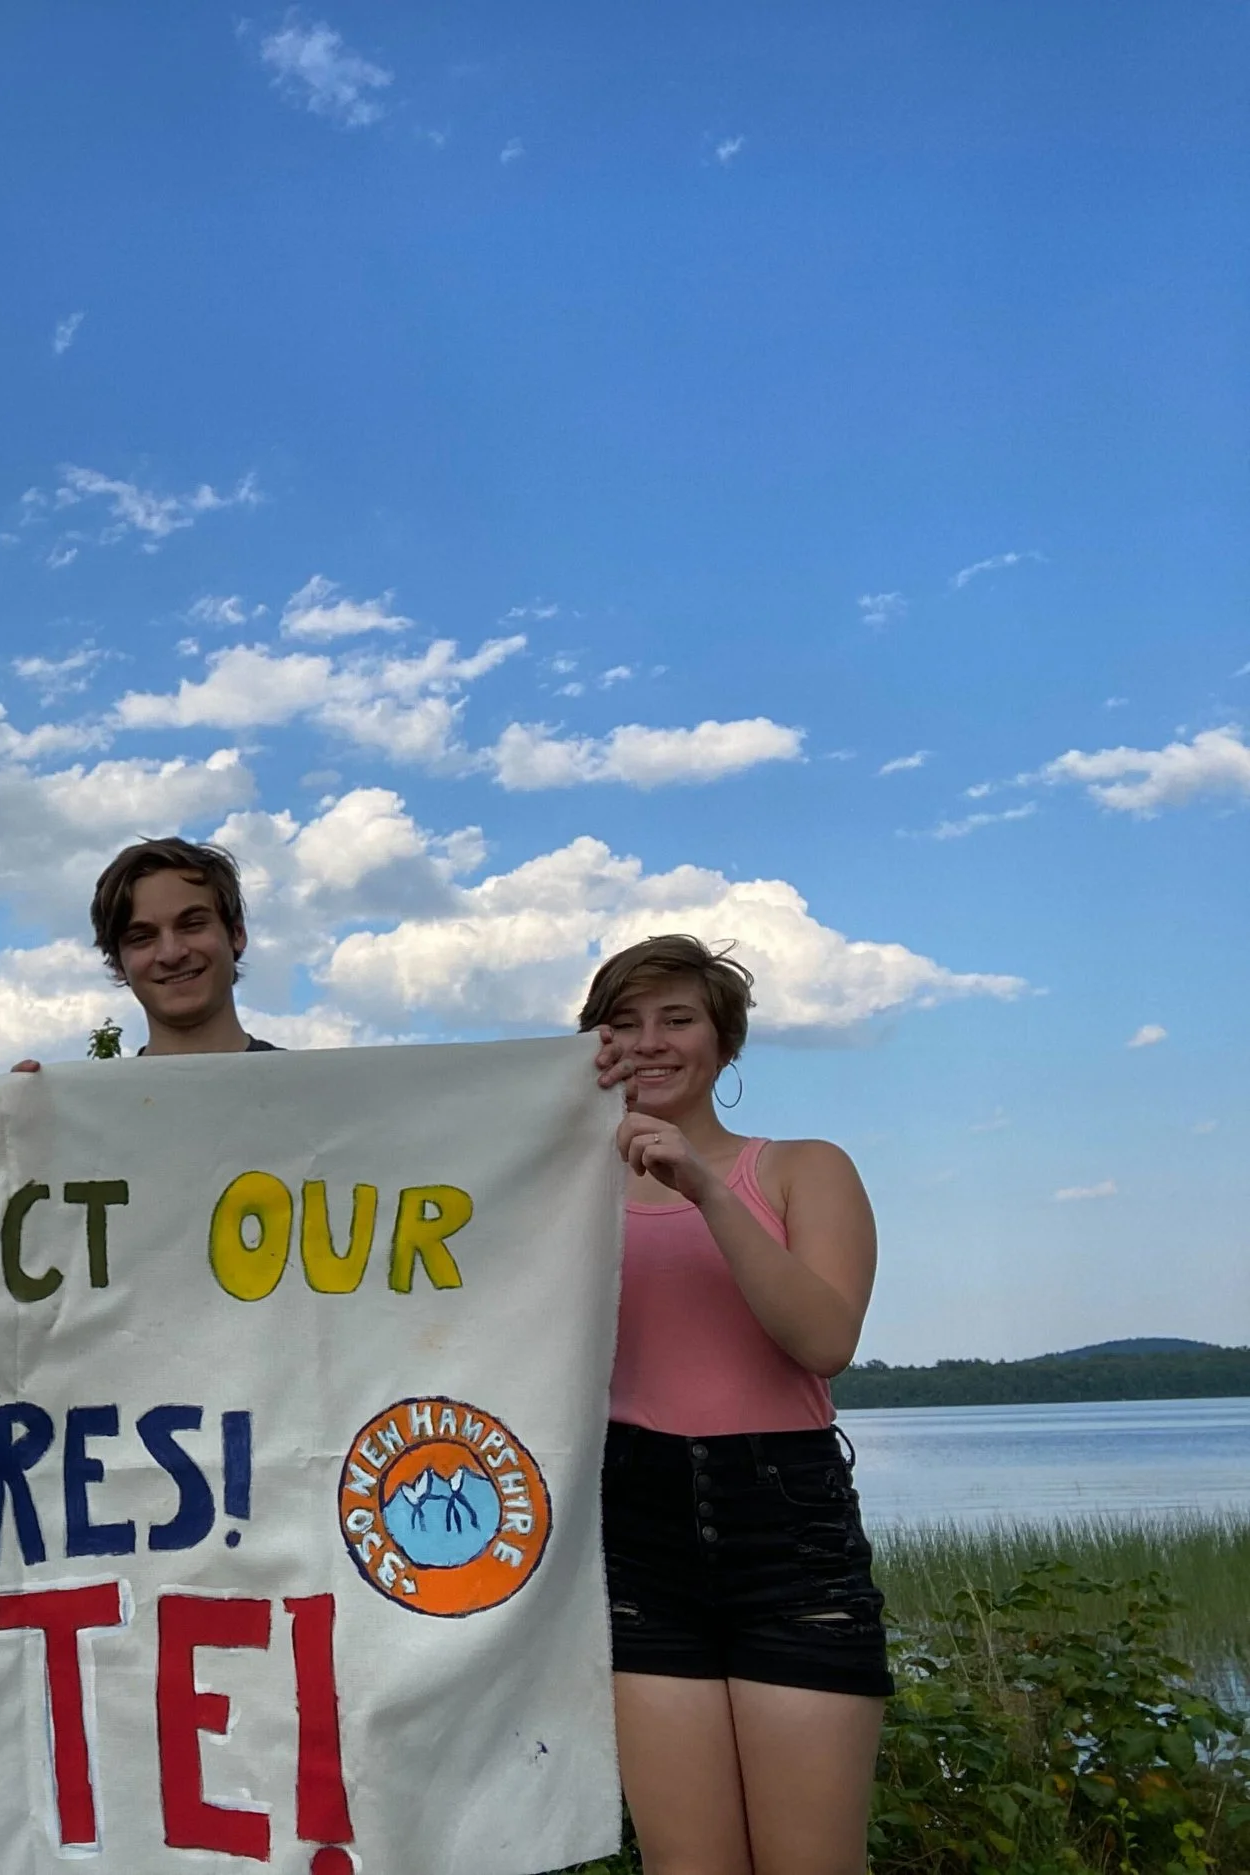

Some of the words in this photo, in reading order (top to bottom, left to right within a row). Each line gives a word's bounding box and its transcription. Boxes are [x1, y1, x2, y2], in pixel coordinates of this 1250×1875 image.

[208, 1171, 473, 1302] OUR
[345, 1420, 405, 1497] NEW
[409, 1404, 532, 1568] HAMPSHIRE
[346, 1508, 405, 1588] 350
